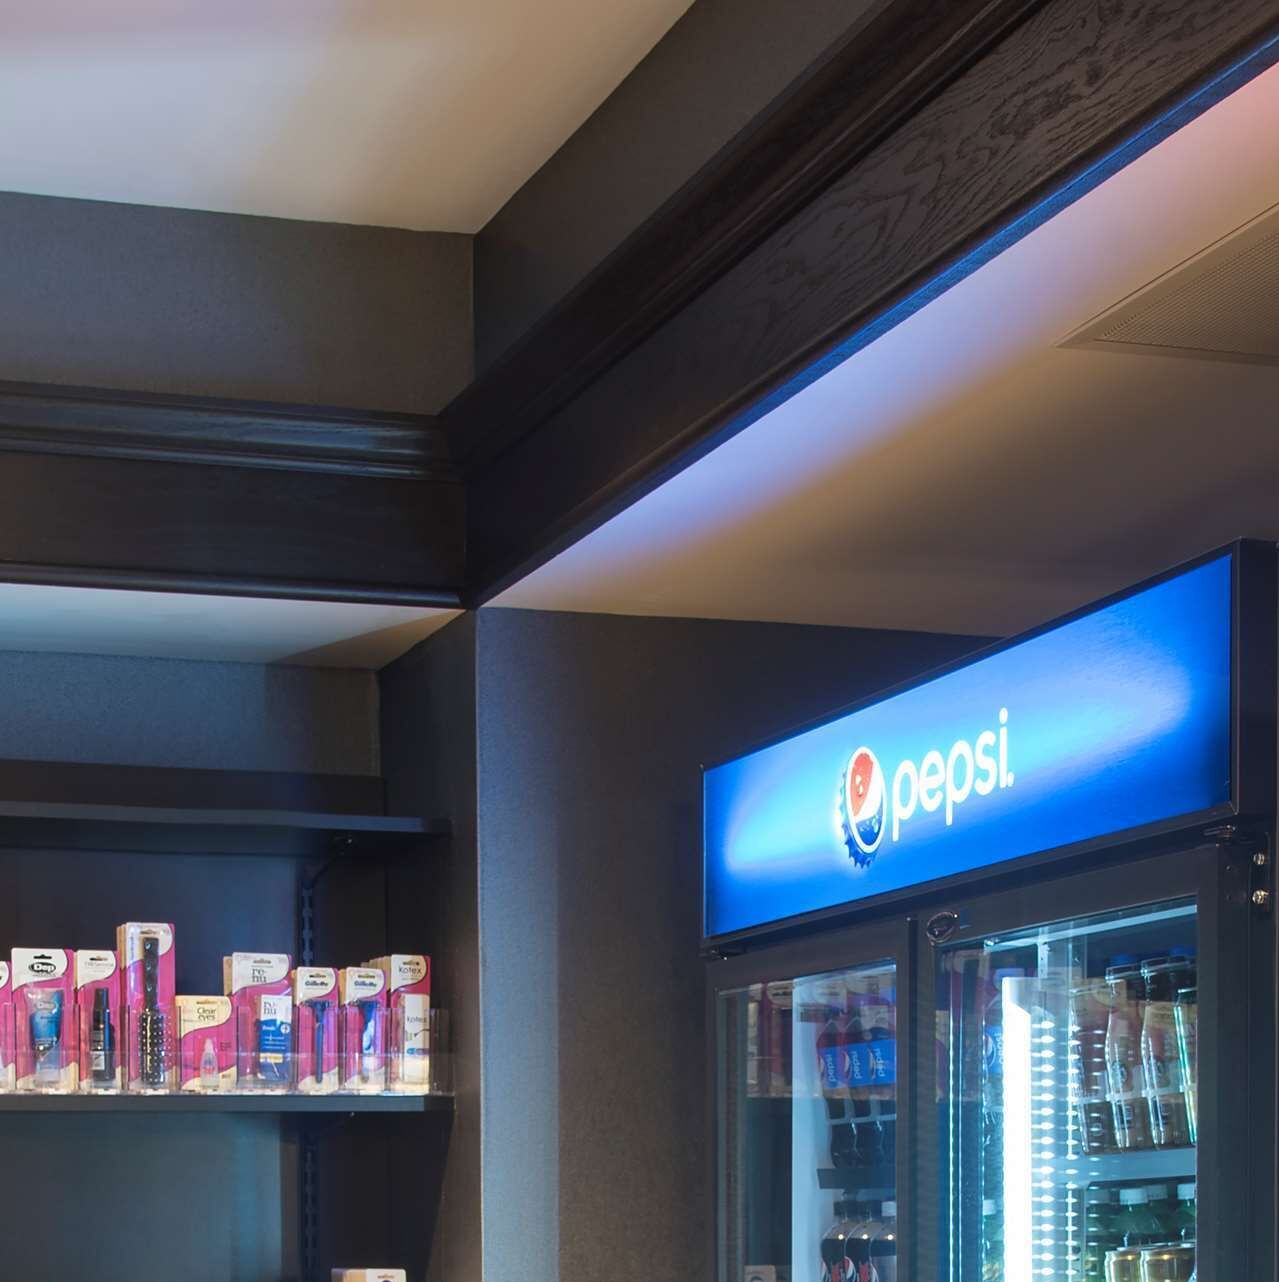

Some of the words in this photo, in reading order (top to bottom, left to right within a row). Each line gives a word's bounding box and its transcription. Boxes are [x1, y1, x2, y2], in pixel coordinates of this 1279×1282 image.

[33, 963, 56, 973] Dep
[197, 1007, 217, 1015] Clear
[198, 1013, 216, 1021] eyes
